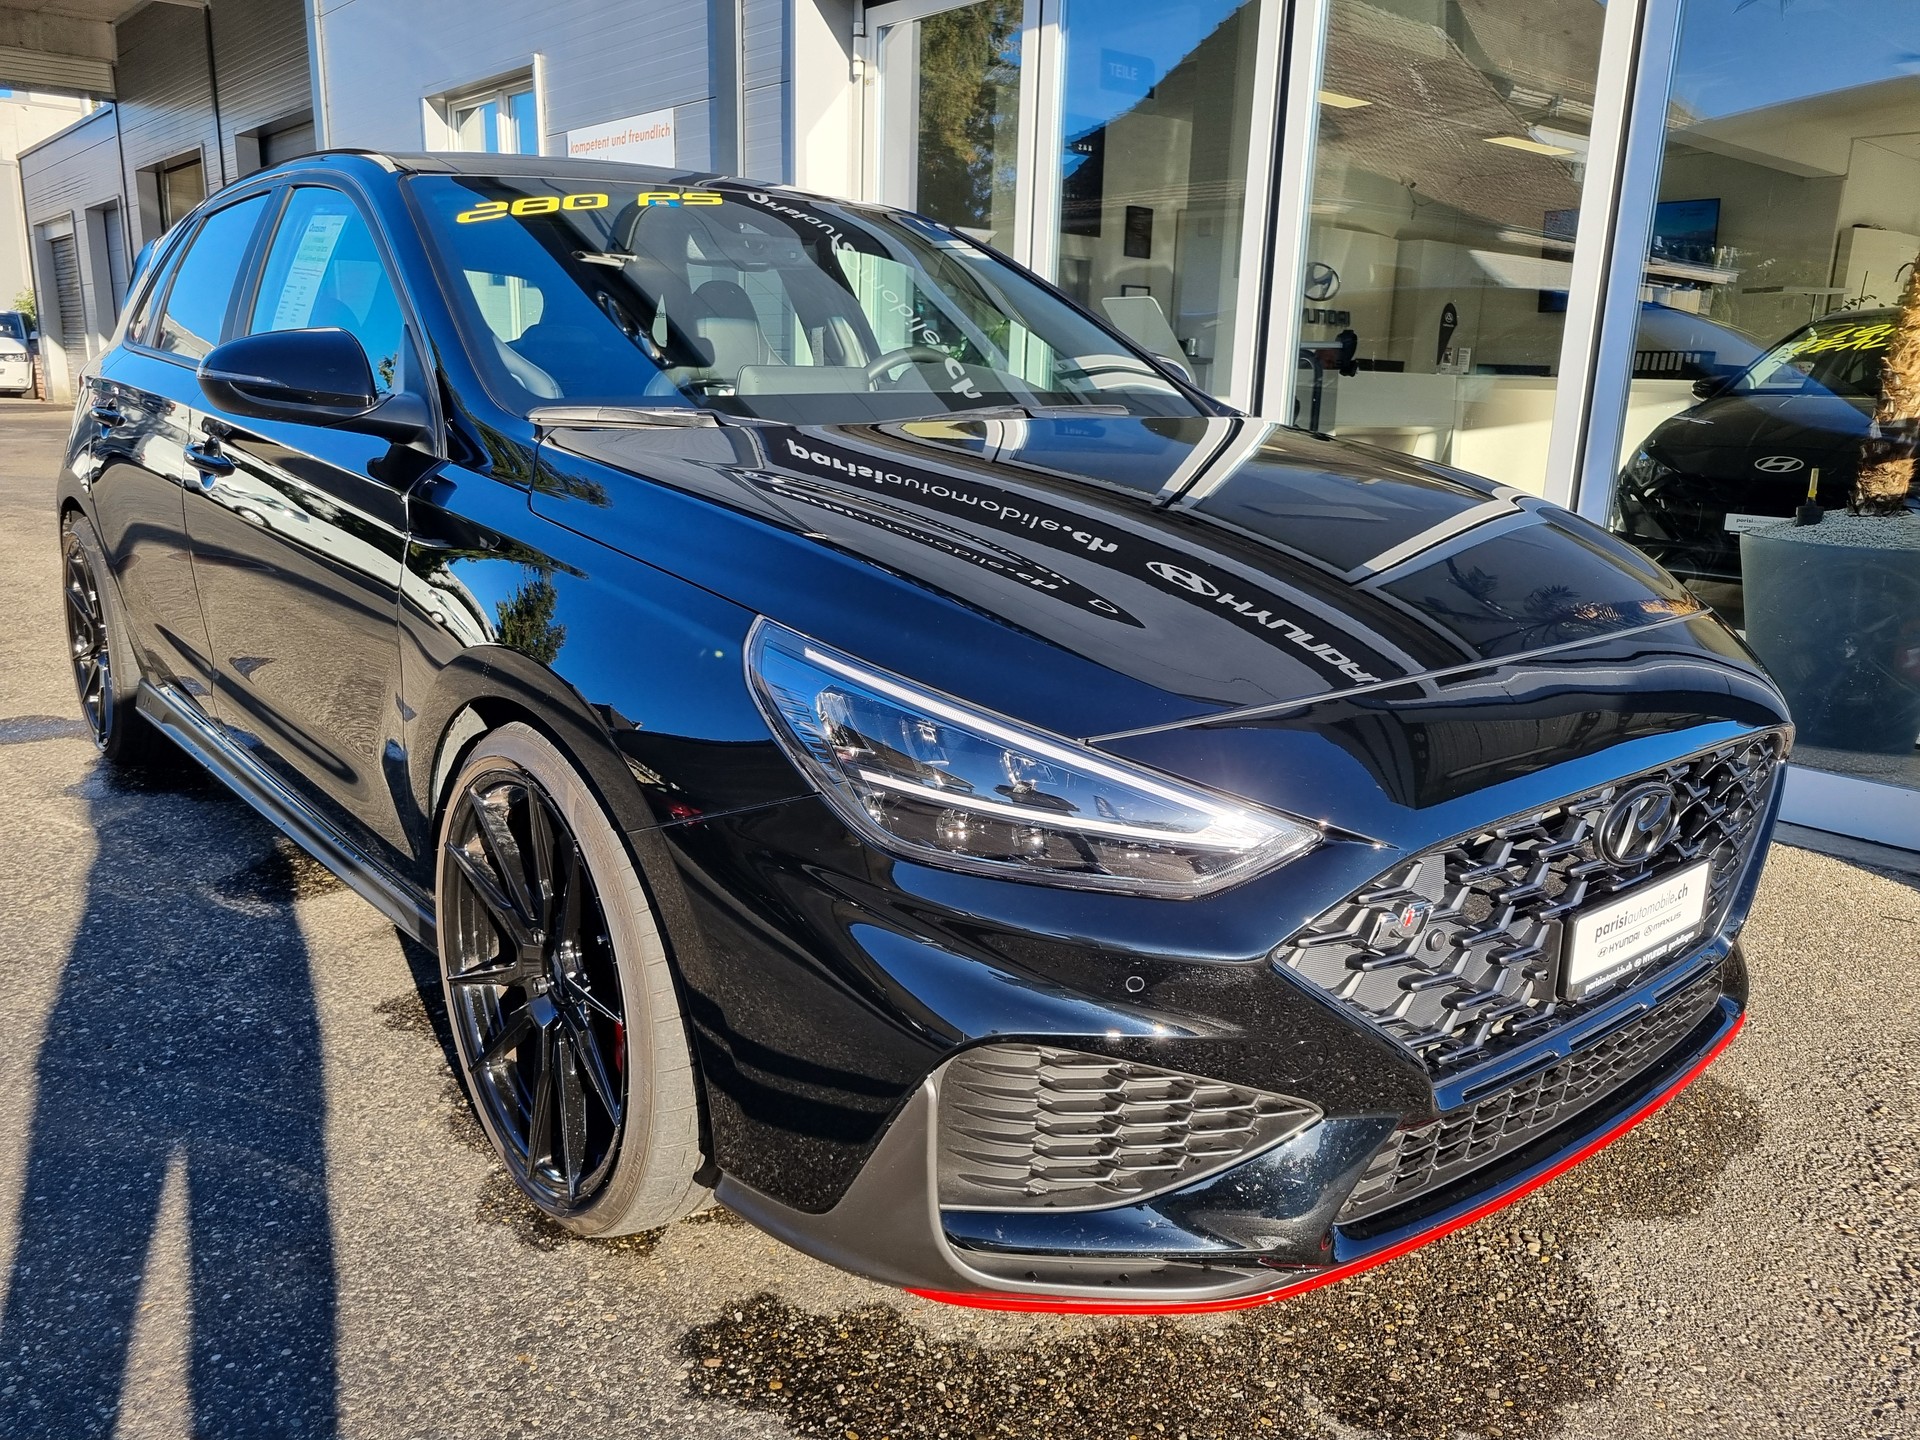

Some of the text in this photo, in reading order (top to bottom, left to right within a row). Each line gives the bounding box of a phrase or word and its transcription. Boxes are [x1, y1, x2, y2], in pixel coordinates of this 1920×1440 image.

[1108, 62, 1139, 81] TEILE
[570, 122, 670, 155] kompetent und freundlich
[456, 192, 723, 223] 280 PS
[1595, 883, 1688, 943] parisiautomobile.ch
[1608, 931, 1640, 954] HYUNDAI
[1642, 944, 1668, 964] HYUNDAI
